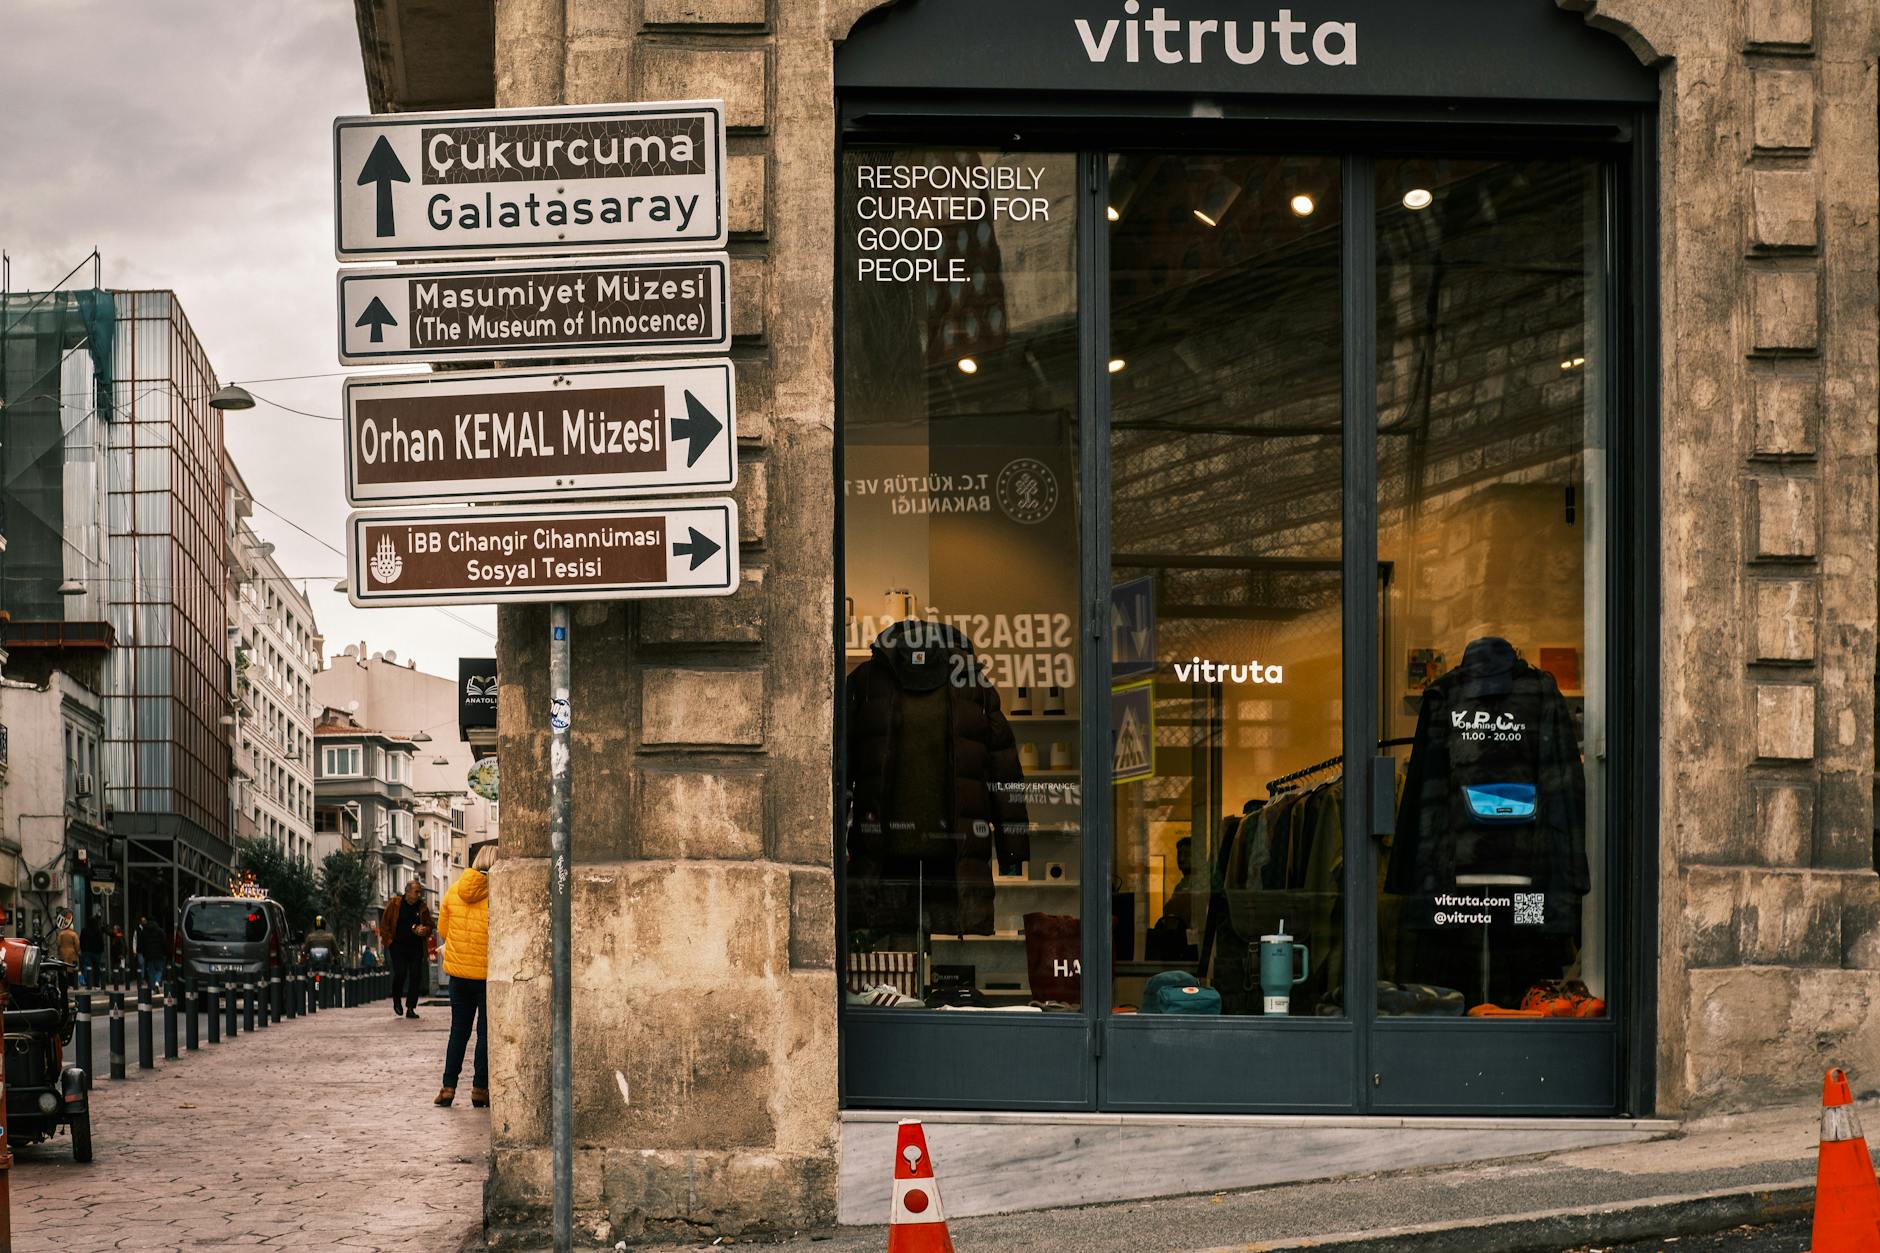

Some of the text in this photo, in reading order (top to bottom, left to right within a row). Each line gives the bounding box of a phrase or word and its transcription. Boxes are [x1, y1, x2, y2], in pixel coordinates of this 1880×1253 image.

[1074, 0, 1357, 66] vitruta
[428, 131, 694, 177] Çukurcuma
[857, 165, 1046, 190] RESPONSIBLY
[427, 191, 699, 232] Galatasaray
[857, 196, 1049, 221] CURATED FOR
[857, 227, 943, 251] GOOD
[858, 258, 971, 282] PEOPLE.
[416, 274, 704, 312] Masumiyet Müzesi
[415, 304, 705, 344] (The Museum of Innocence)
[360, 408, 661, 465] Orhan KEMAL Müzesi
[408, 527, 661, 556] İBB Cihangir Cihannüması
[466, 556, 602, 586] Sosyal Tesisi
[1173, 656, 1283, 684] vitruta
[1461, 732, 1486, 740] 11.00
[1494, 732, 1522, 741] 20.00
[1032, 782, 1076, 790] ENTRANCE
[1434, 893, 1511, 907] vitruta.com
[1433, 911, 1492, 925] @vitruta
